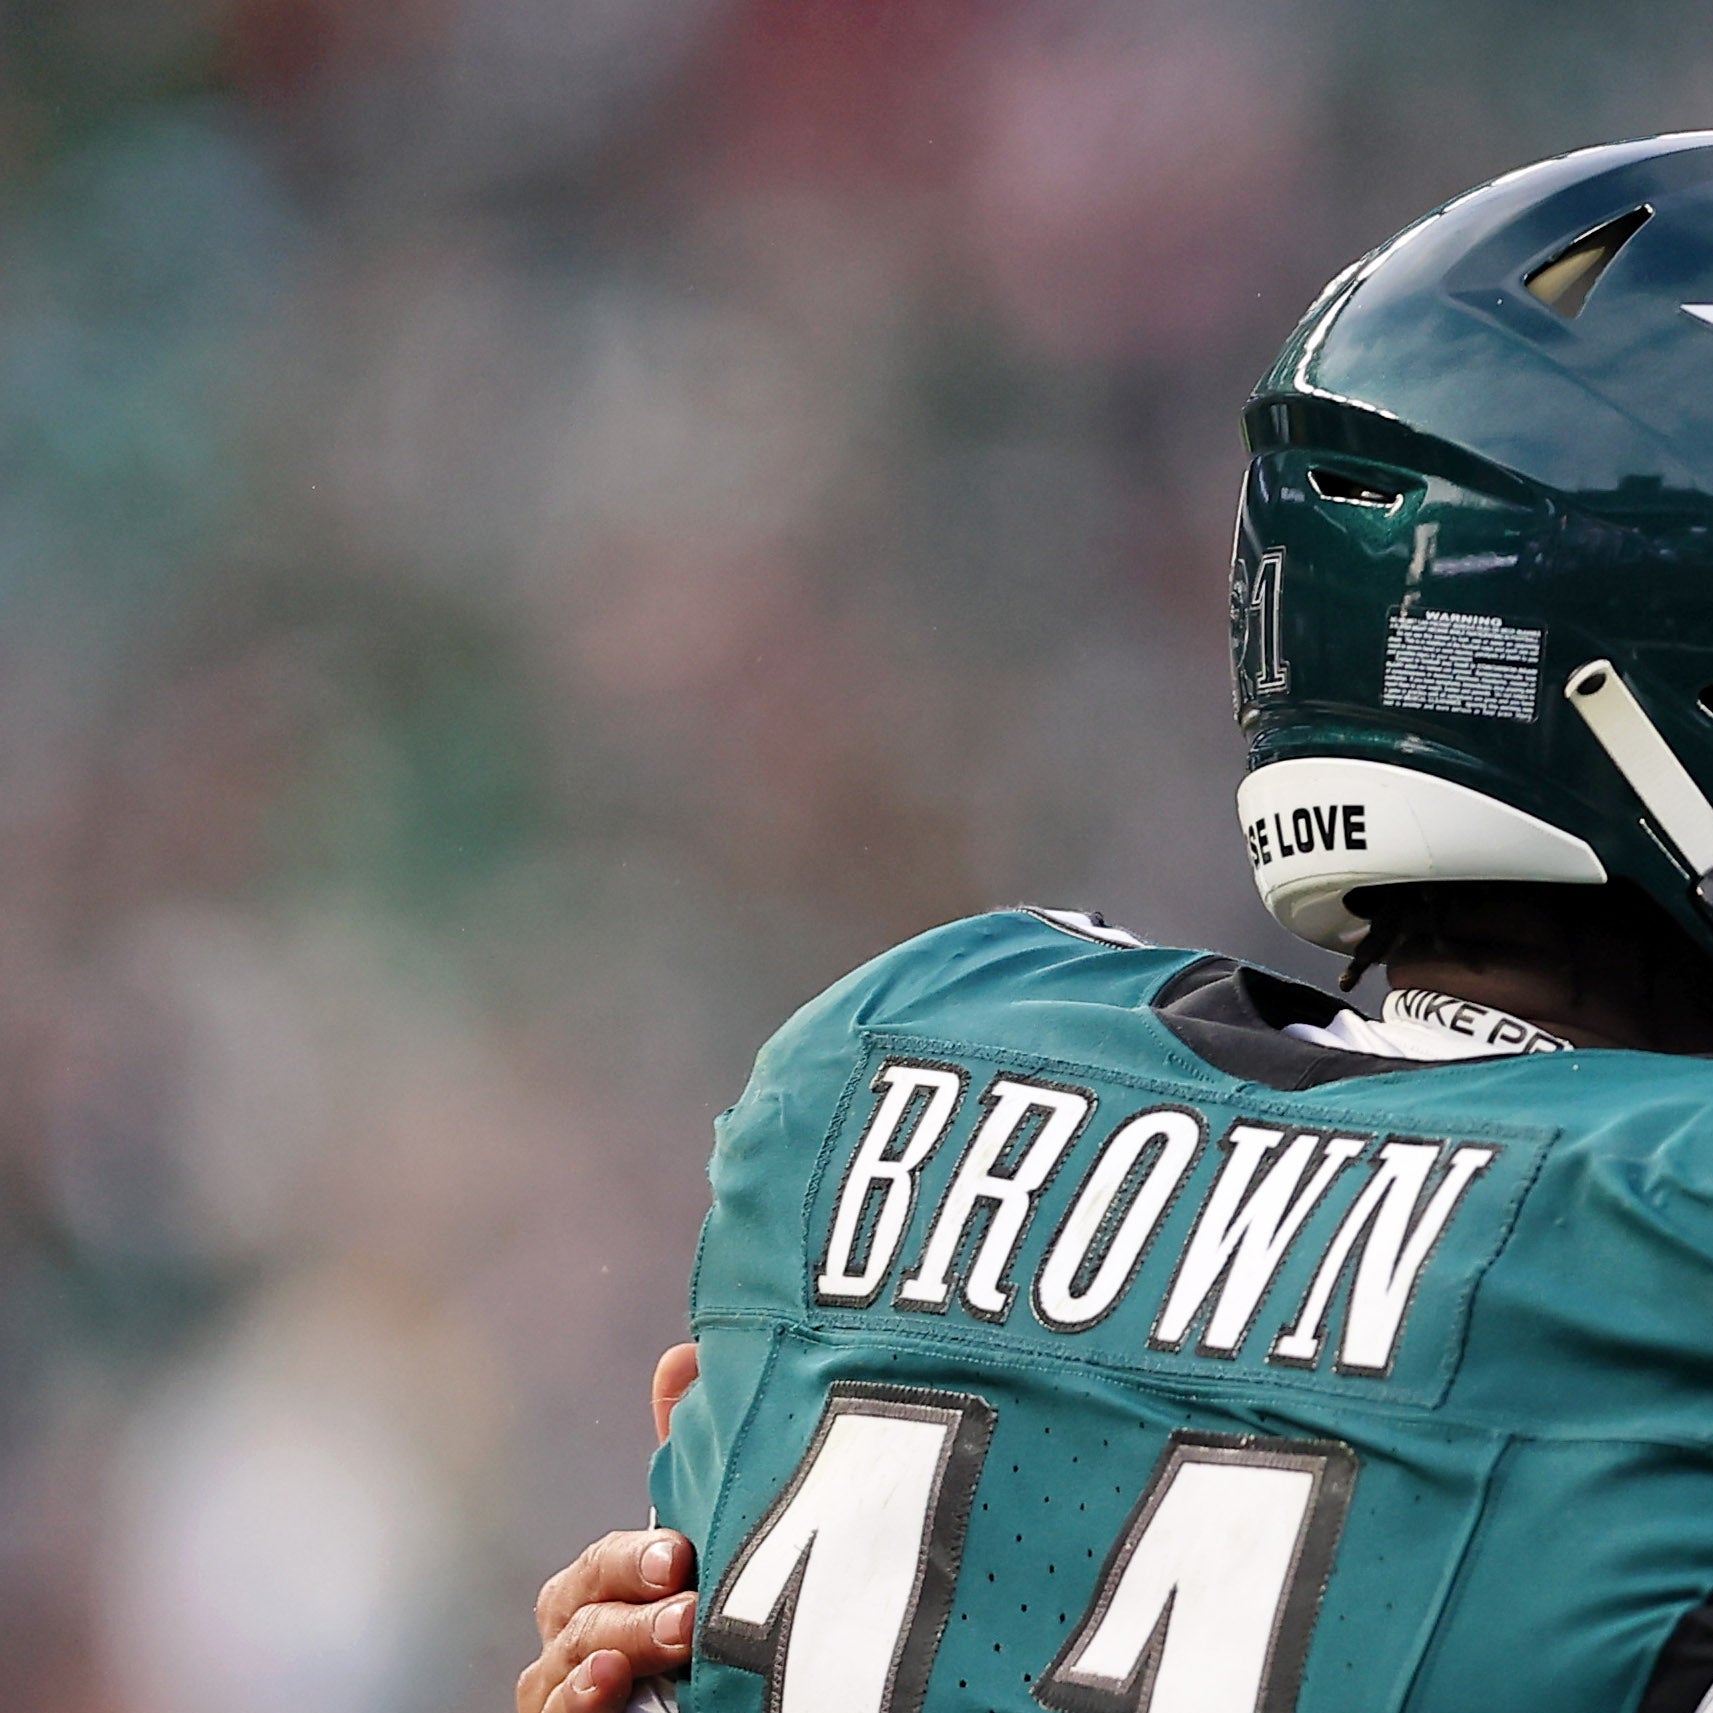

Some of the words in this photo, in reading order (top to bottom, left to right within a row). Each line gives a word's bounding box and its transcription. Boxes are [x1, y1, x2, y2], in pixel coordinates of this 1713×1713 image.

[1426, 610, 1503, 627] WARNING
[1274, 804, 1368, 858] LOVE
[1395, 988, 1488, 1036] NIKE
[812, 1055, 1503, 1379] BROWN
